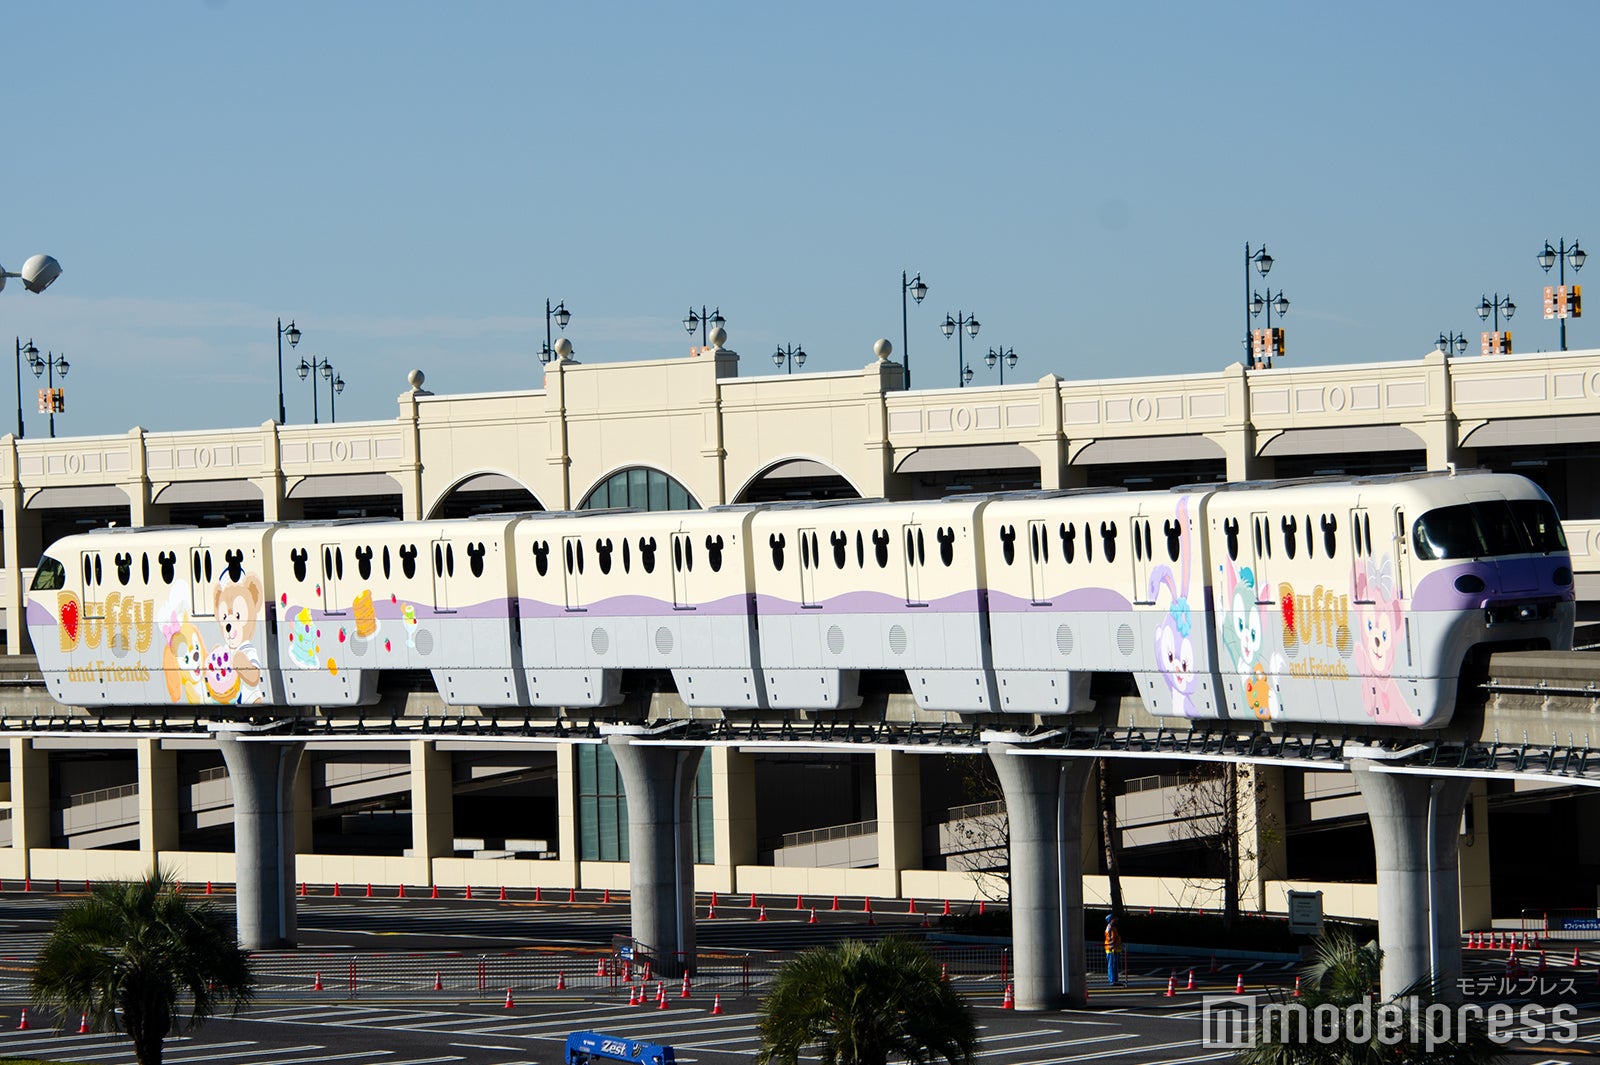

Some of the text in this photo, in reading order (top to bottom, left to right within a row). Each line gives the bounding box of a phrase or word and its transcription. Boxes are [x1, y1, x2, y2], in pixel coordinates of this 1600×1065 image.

[57, 590, 154, 653] Duffy
[1278, 581, 1348, 651] Duffy
[67, 660, 150, 682] and Friends
[1289, 656, 1349, 681] and Friends
[601, 1040, 627, 1056] Zest
